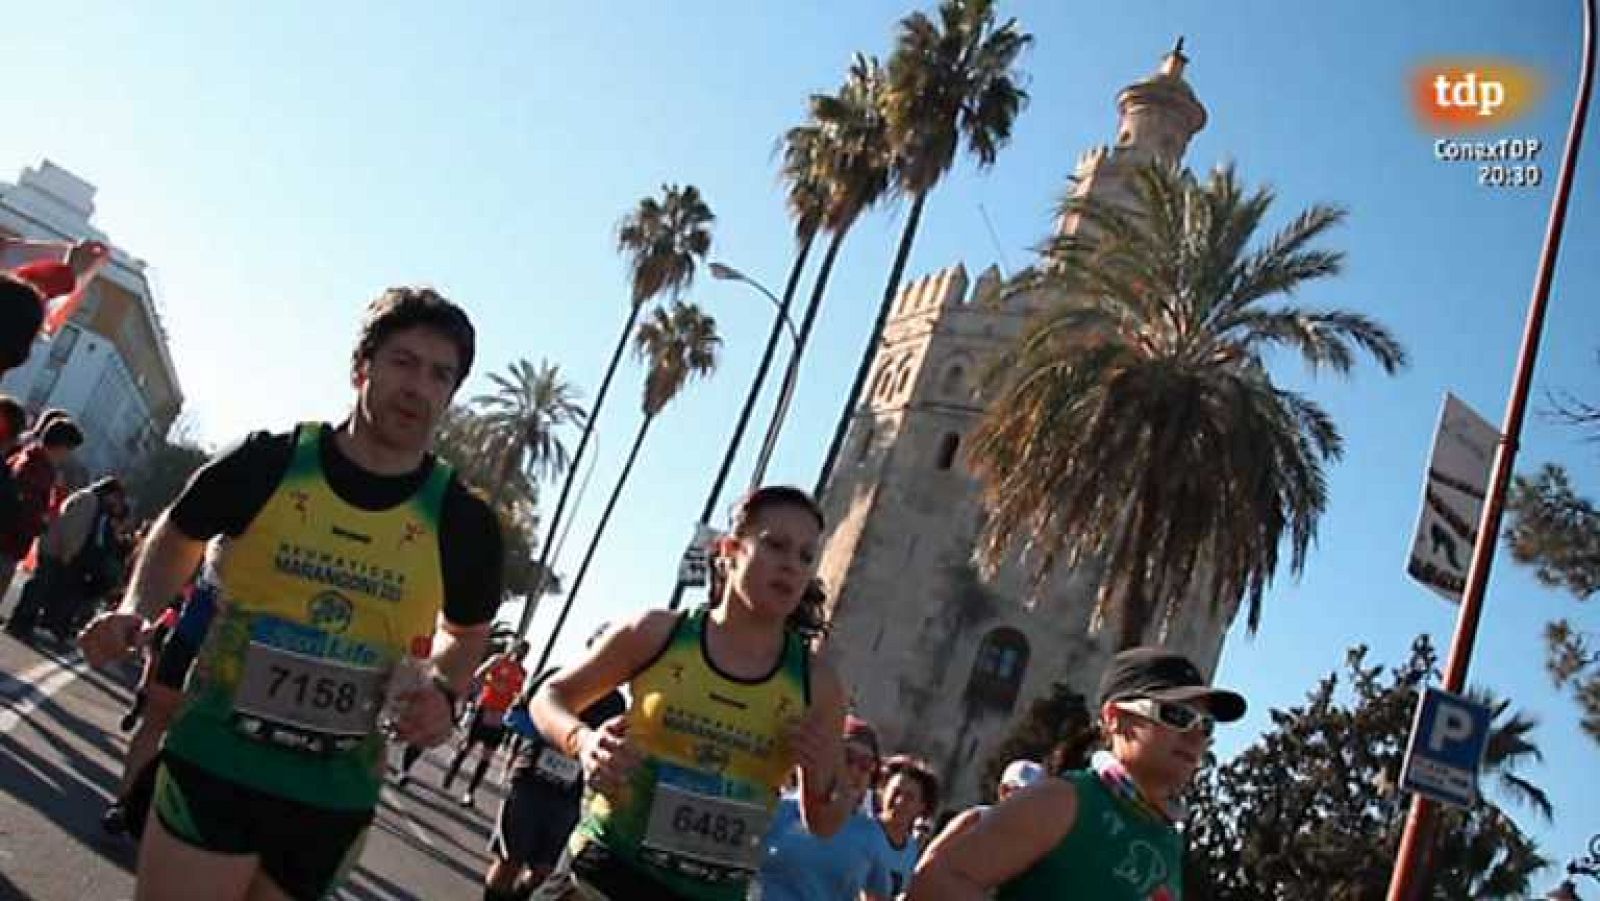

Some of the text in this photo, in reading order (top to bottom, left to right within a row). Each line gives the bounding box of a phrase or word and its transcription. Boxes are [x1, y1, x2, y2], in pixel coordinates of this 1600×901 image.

[268, 665, 357, 713] 7158
[1430, 702, 1473, 752] P
[673, 805, 746, 847] 6482
